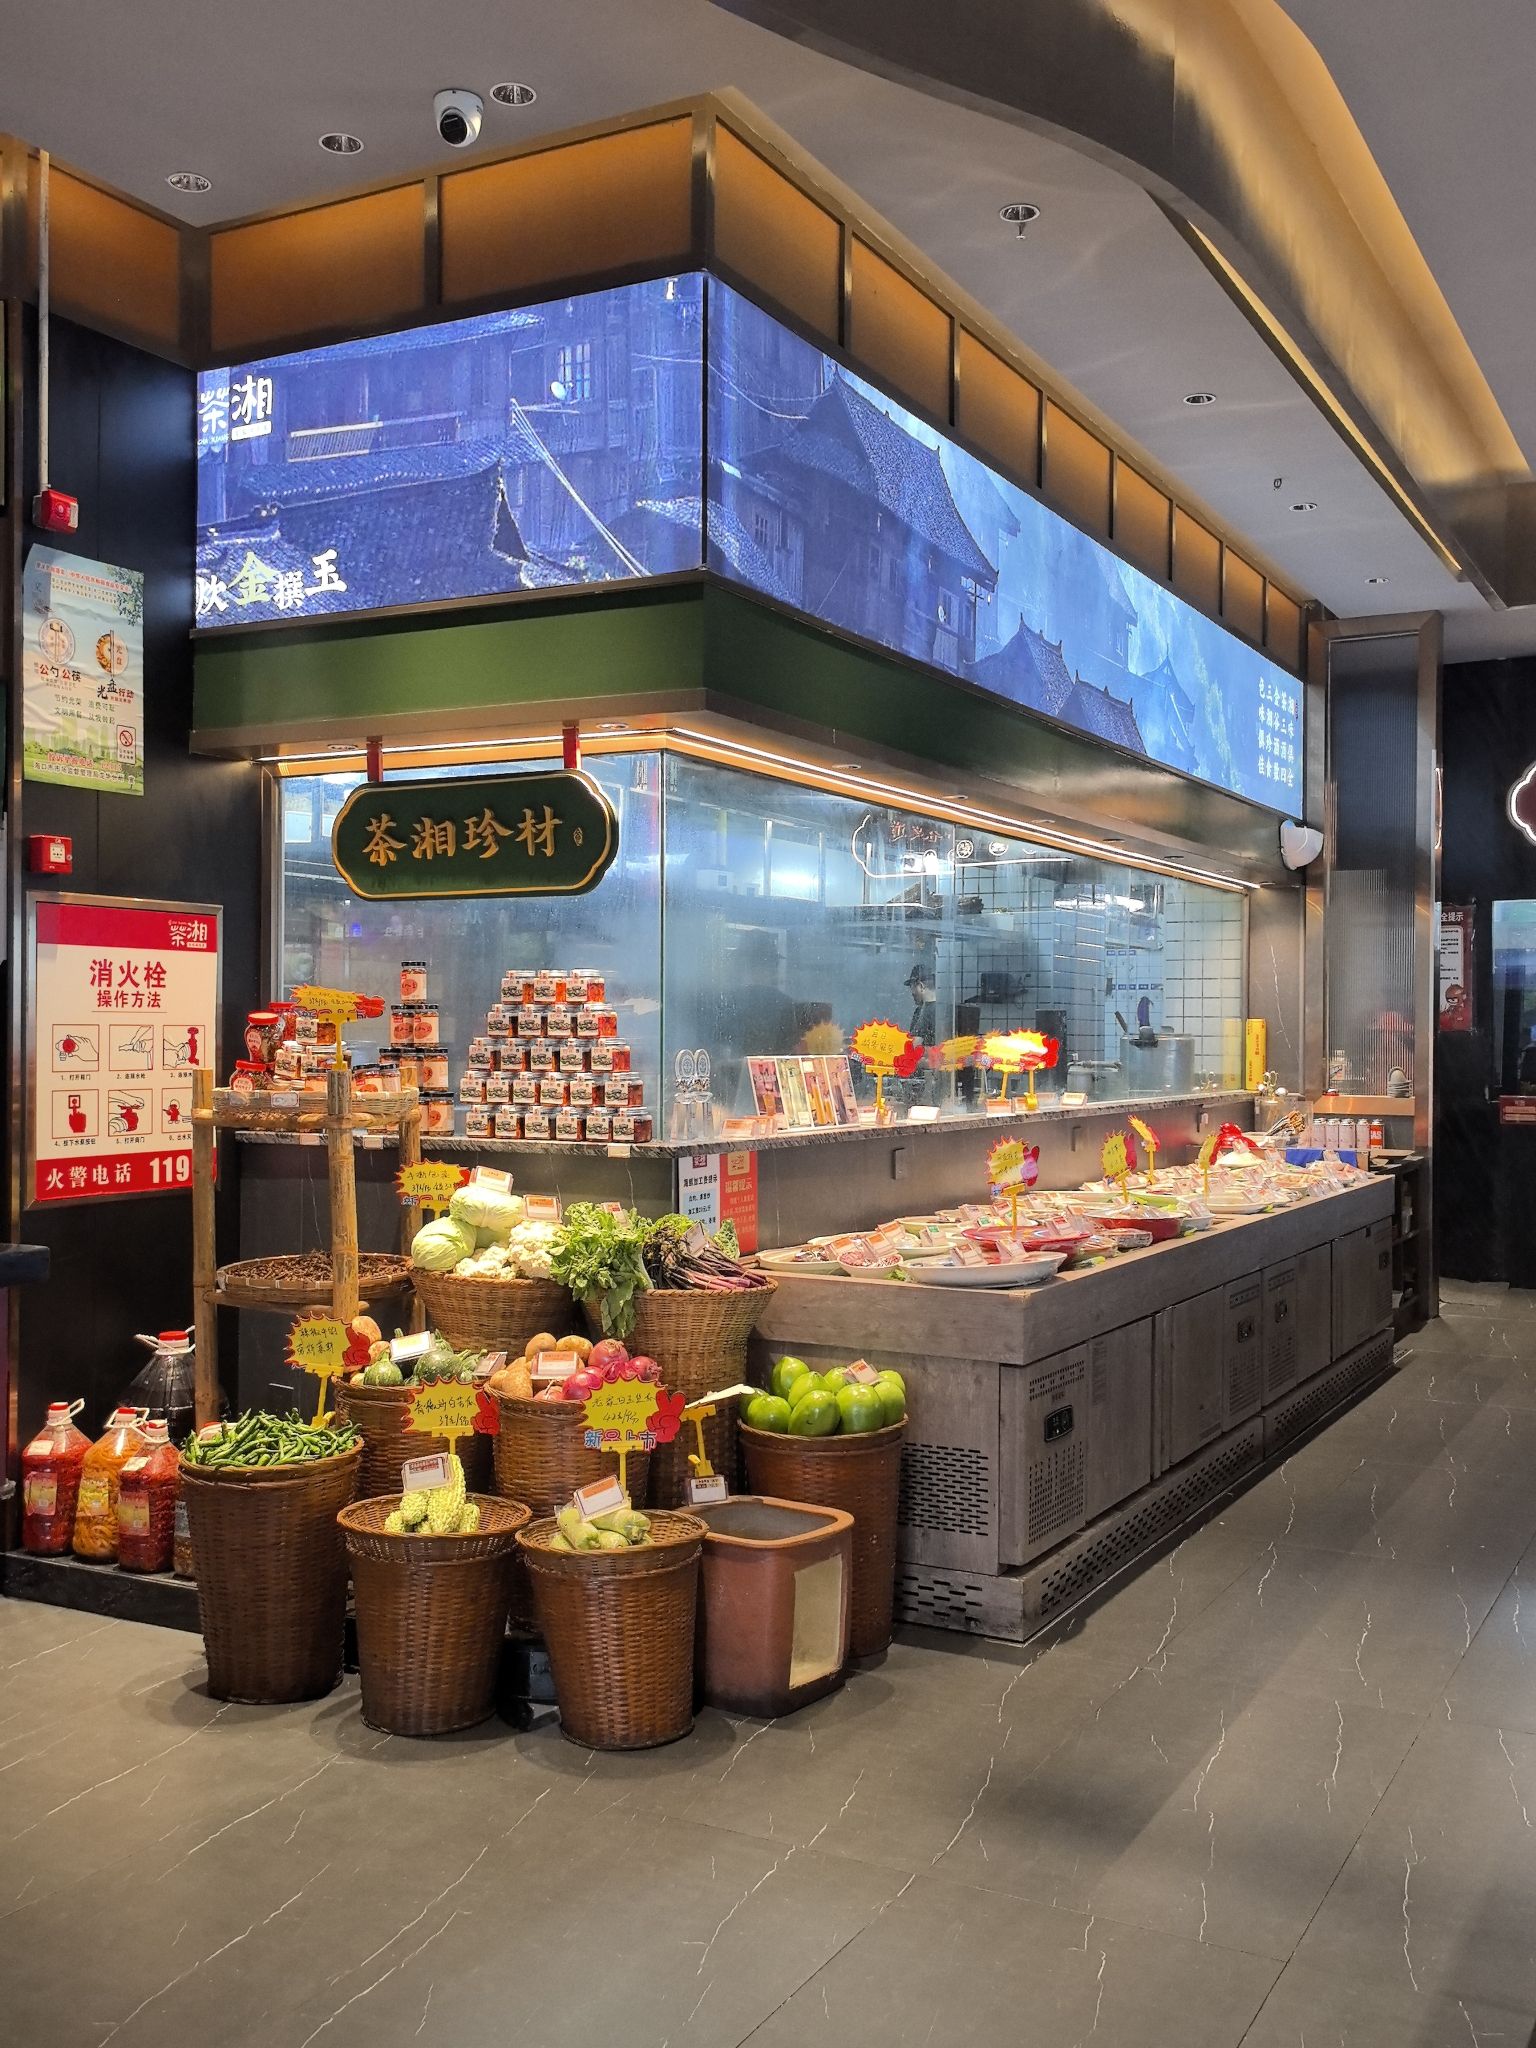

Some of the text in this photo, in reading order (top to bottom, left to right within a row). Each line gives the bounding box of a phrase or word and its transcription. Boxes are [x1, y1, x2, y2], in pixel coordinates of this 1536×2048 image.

[198, 374, 273, 434] 茶湘
[40, 664, 81, 682] 公勺公筷
[97, 678, 134, 699] 光盘行动
[362, 805, 563, 867] 茶湘珍材
[169, 919, 208, 947] 茶湘
[89, 958, 167, 989] 消火栓
[97, 989, 161, 1008] 操作方法
[46, 1155, 190, 1190] 火警电话 119
[439, 1412, 469, 1426] 39元/份
